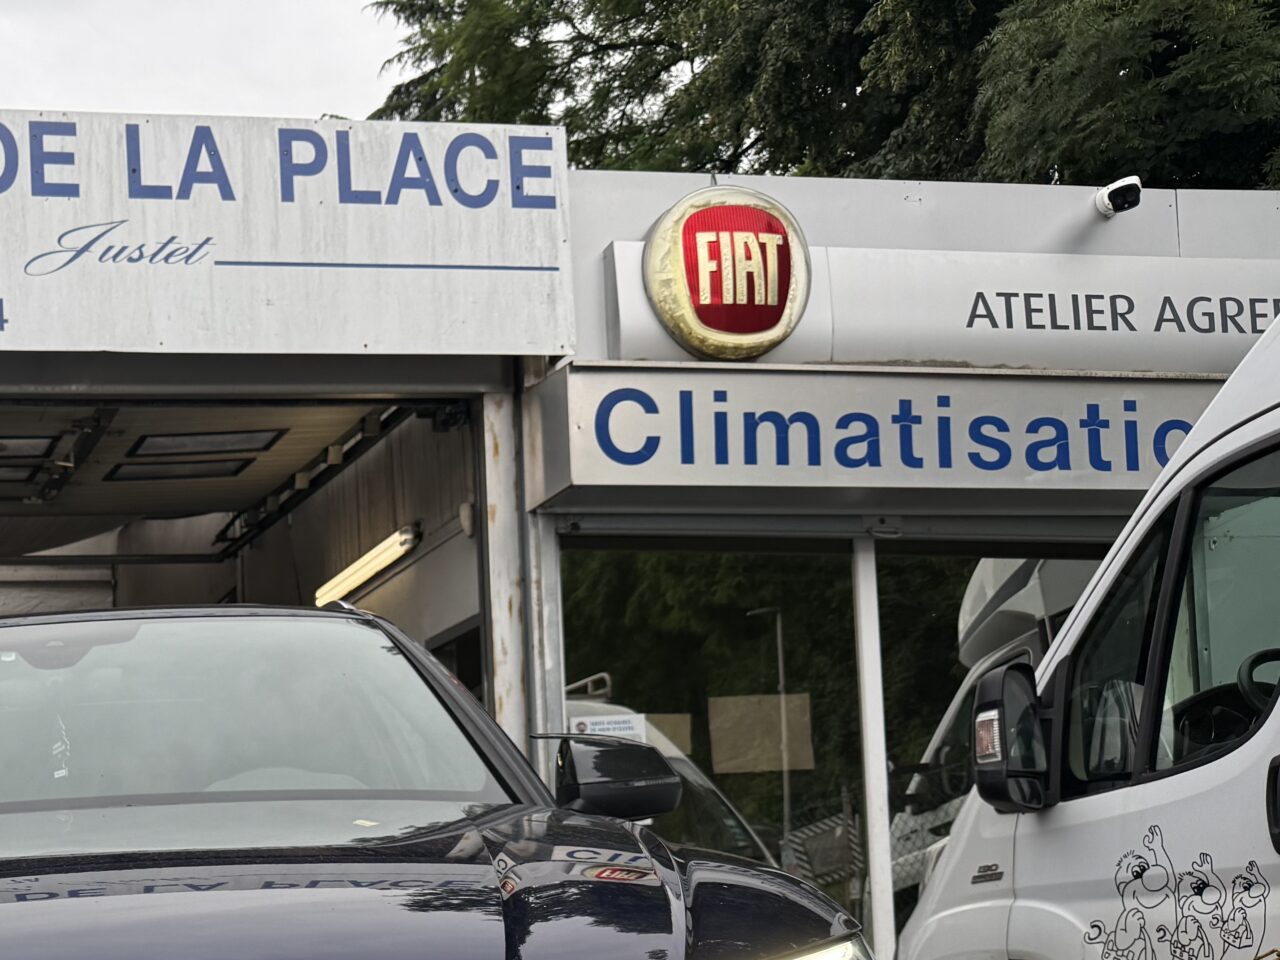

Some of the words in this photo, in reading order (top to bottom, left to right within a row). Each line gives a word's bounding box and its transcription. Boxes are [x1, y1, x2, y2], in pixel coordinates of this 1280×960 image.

[125, 123, 237, 202] LA
[278, 127, 557, 209] PLACE
[24, 219, 216, 276] Justet
[695, 231, 784, 306] FIAT
[966, 291, 1138, 332] ATELIER
